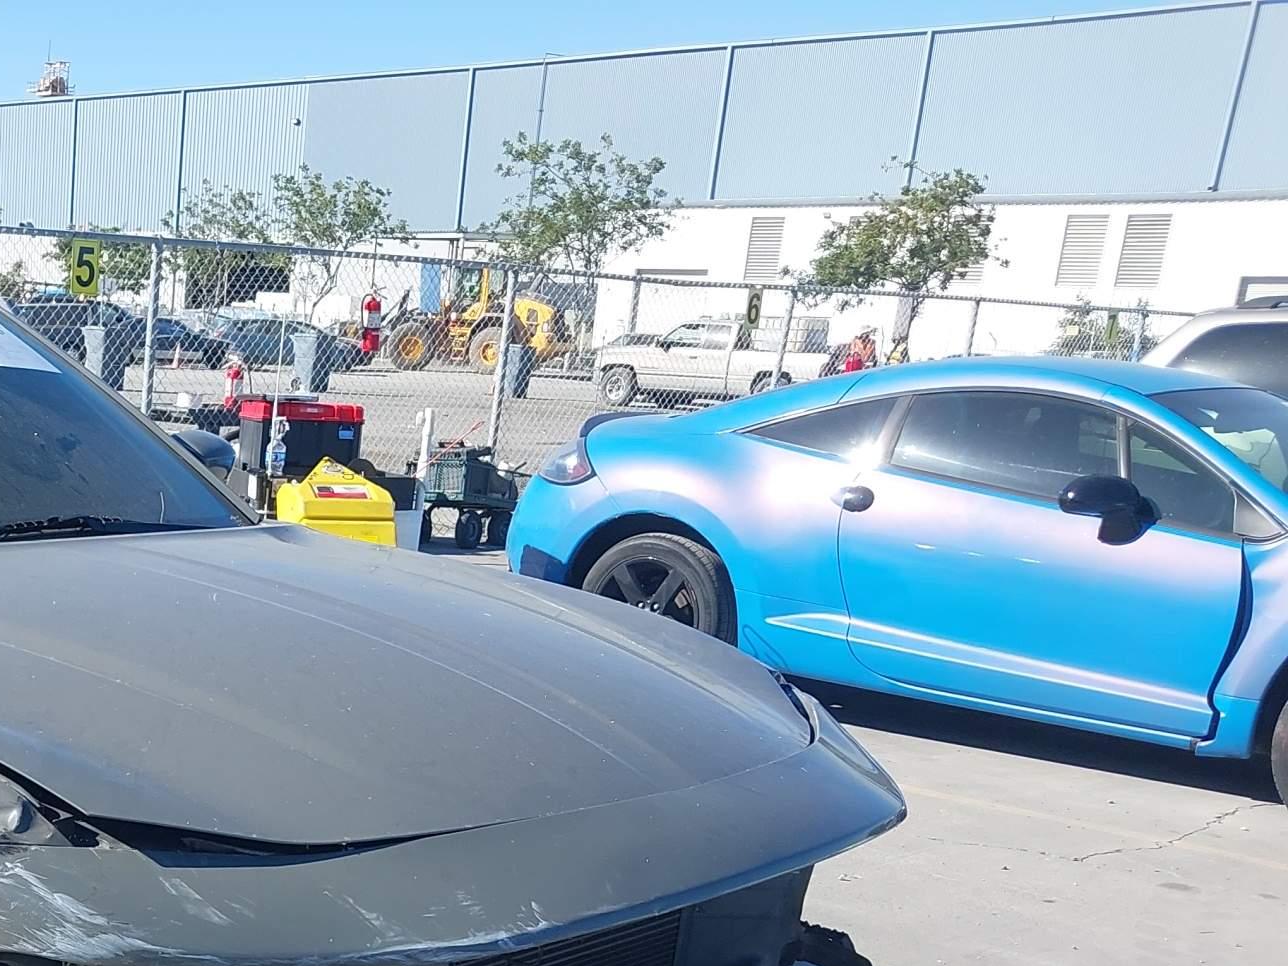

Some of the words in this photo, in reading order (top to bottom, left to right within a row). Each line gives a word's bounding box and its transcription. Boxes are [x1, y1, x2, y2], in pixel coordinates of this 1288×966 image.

[75, 246, 95, 287] 5
[747, 292, 761, 325] 6
[1108, 314, 1117, 340] 7
